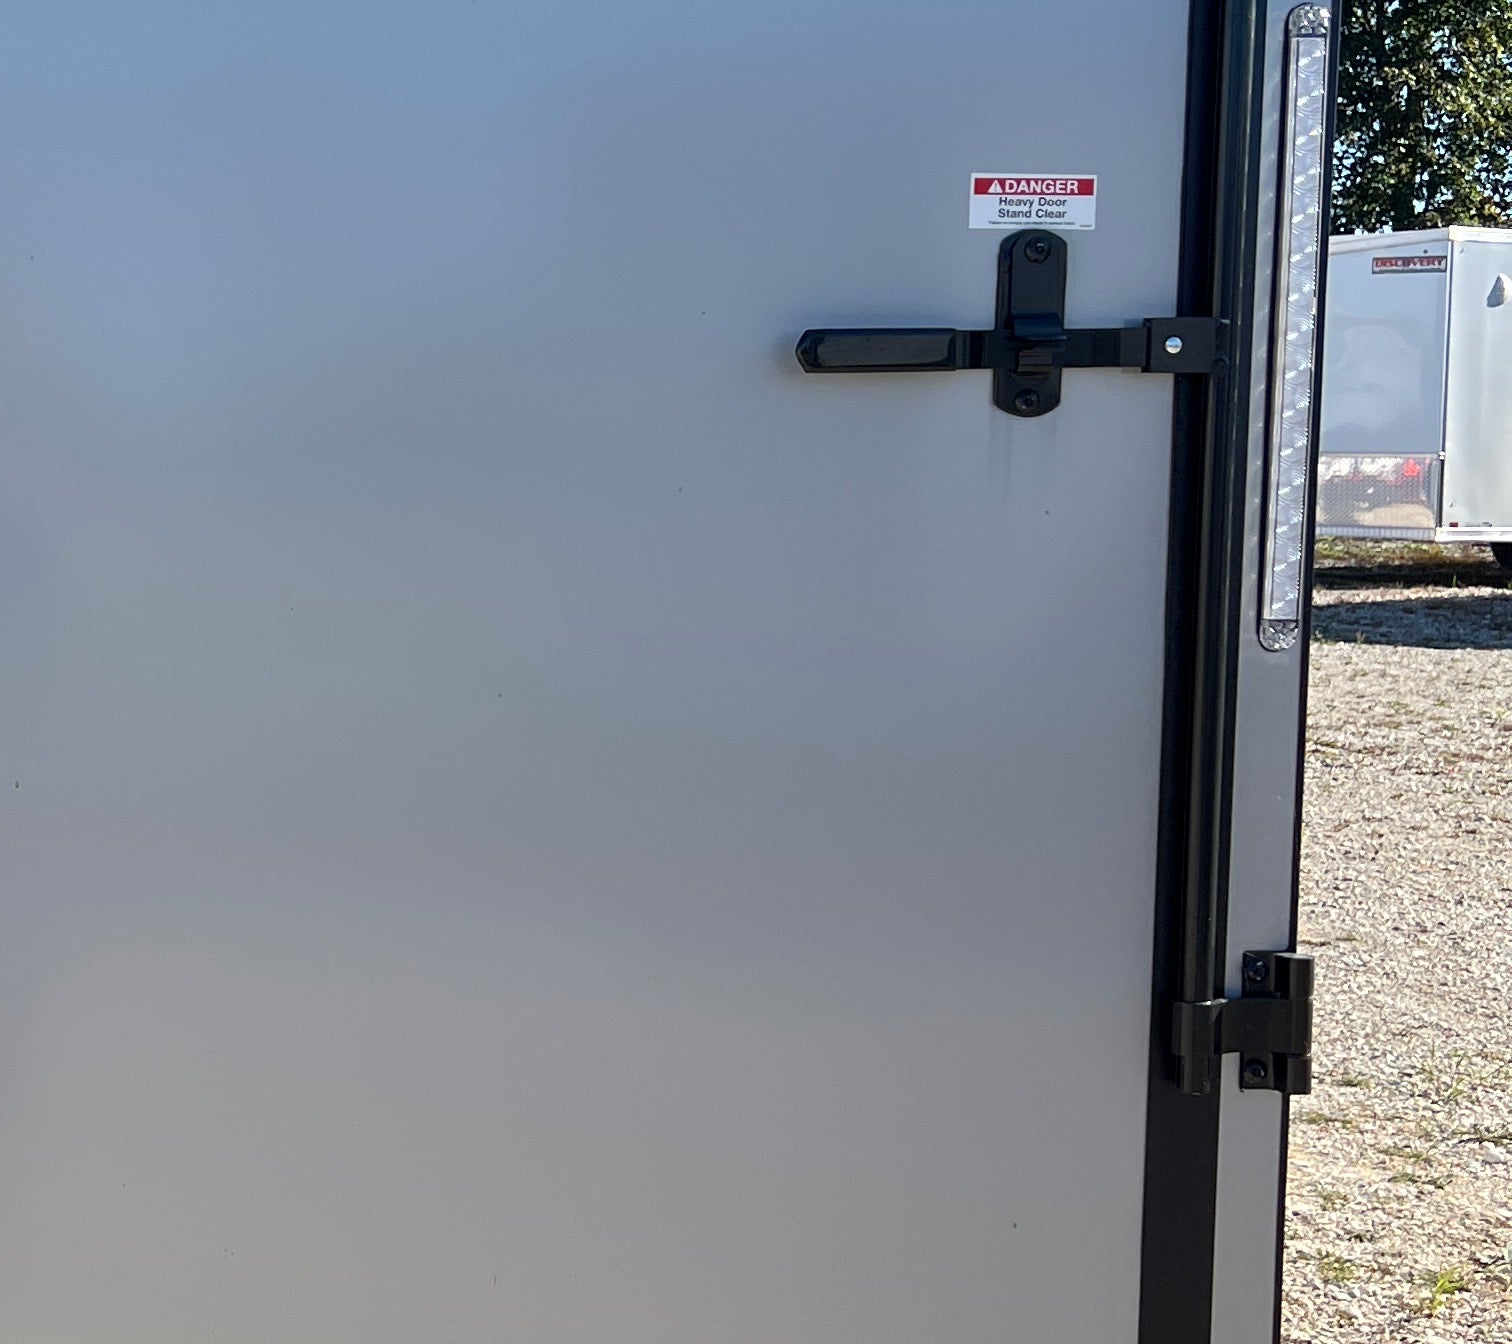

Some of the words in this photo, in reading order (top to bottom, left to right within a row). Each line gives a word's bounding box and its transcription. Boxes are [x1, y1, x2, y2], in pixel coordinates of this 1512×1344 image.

[1004, 179, 1079, 194] DANGER
[998, 197, 1035, 209] Heavy
[1038, 197, 1067, 207] Door
[997, 208, 1032, 219] Stand
[1035, 208, 1067, 219] Clear
